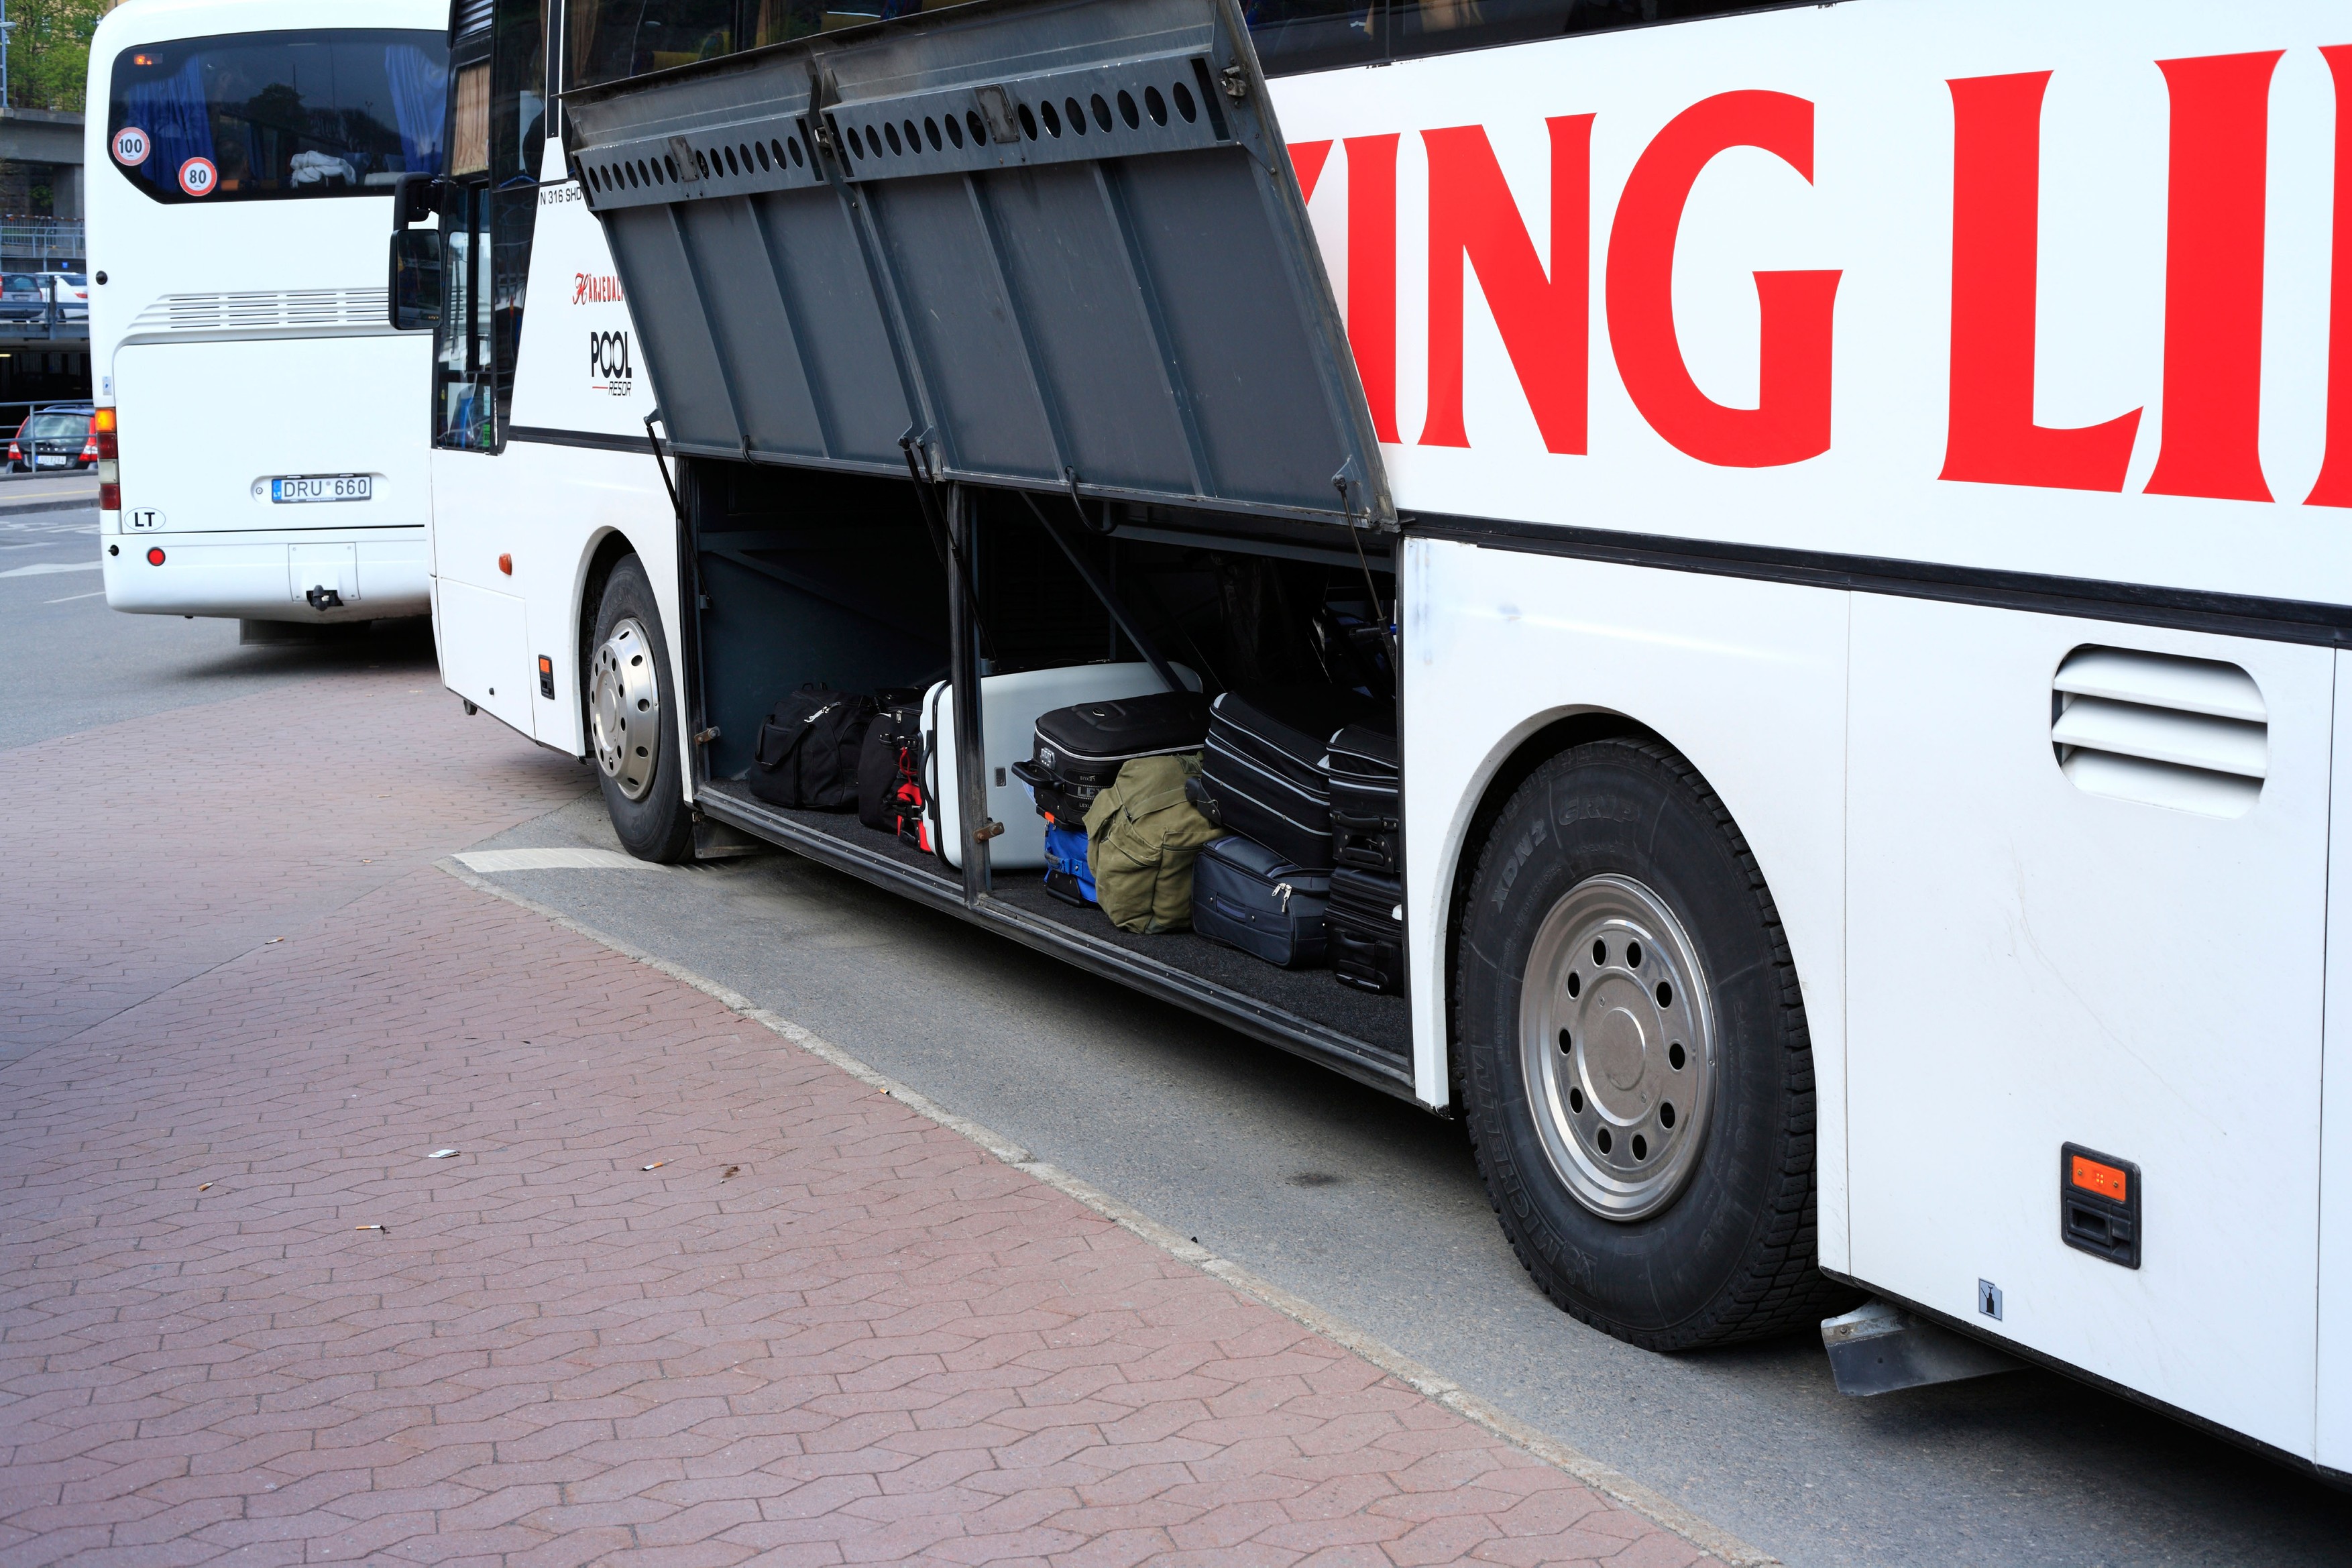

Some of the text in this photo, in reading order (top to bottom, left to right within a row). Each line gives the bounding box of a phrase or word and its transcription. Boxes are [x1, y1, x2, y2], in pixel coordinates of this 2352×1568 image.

[119, 139, 142, 154] 100
[189, 170, 207, 184] 80
[541, 187, 581, 205] N 316 SHD
[1938, 45, 2352, 508] LI
[573, 272, 624, 305] HÄRJEDAL
[590, 331, 632, 378] POOL
[608, 381, 631, 396] RESOR
[284, 479, 367, 498] DRU 660
[134, 512, 155, 526] LT
[1474, 1056, 1561, 1266] MICHELIN
